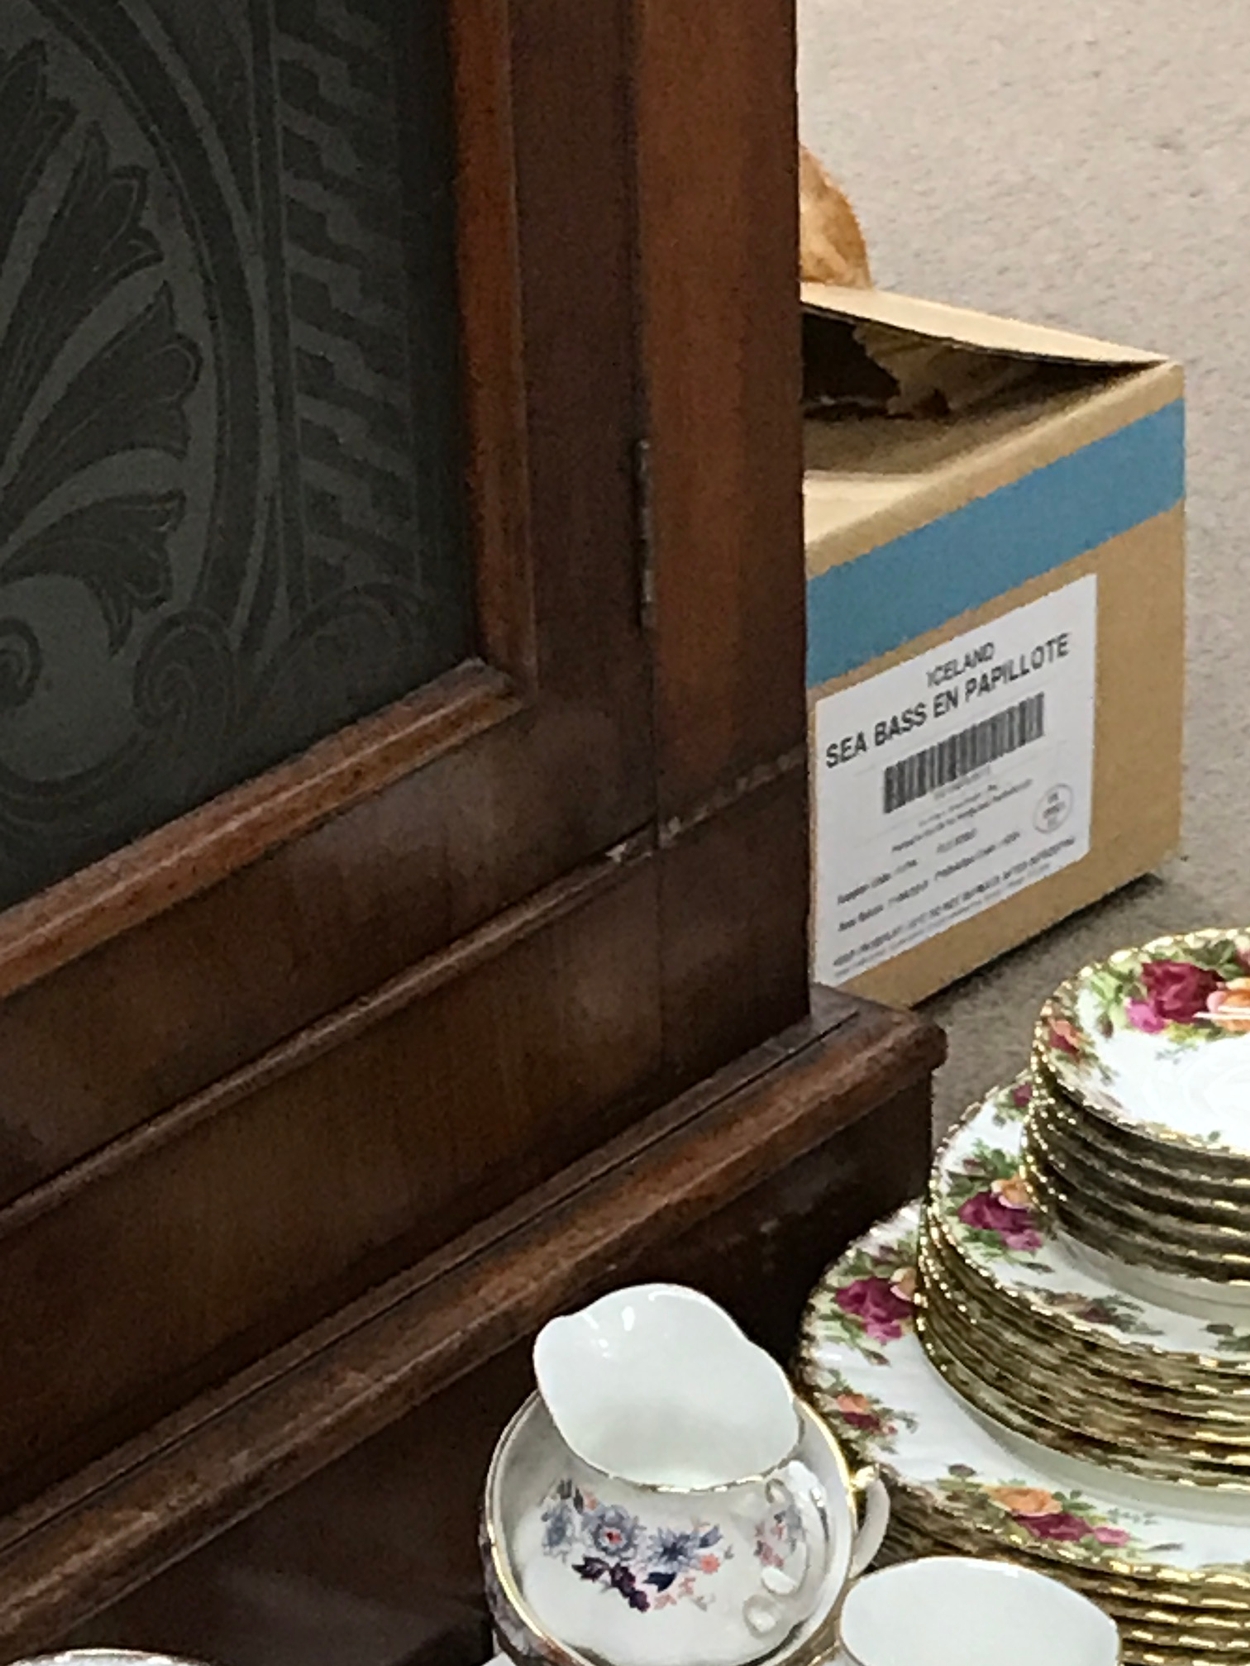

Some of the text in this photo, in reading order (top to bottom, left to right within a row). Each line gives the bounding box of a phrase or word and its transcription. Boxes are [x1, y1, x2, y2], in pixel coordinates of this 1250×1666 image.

[825, 631, 1071, 769] SEA BASS EN PAPILLOTE
[926, 641, 996, 688] ICELAND
